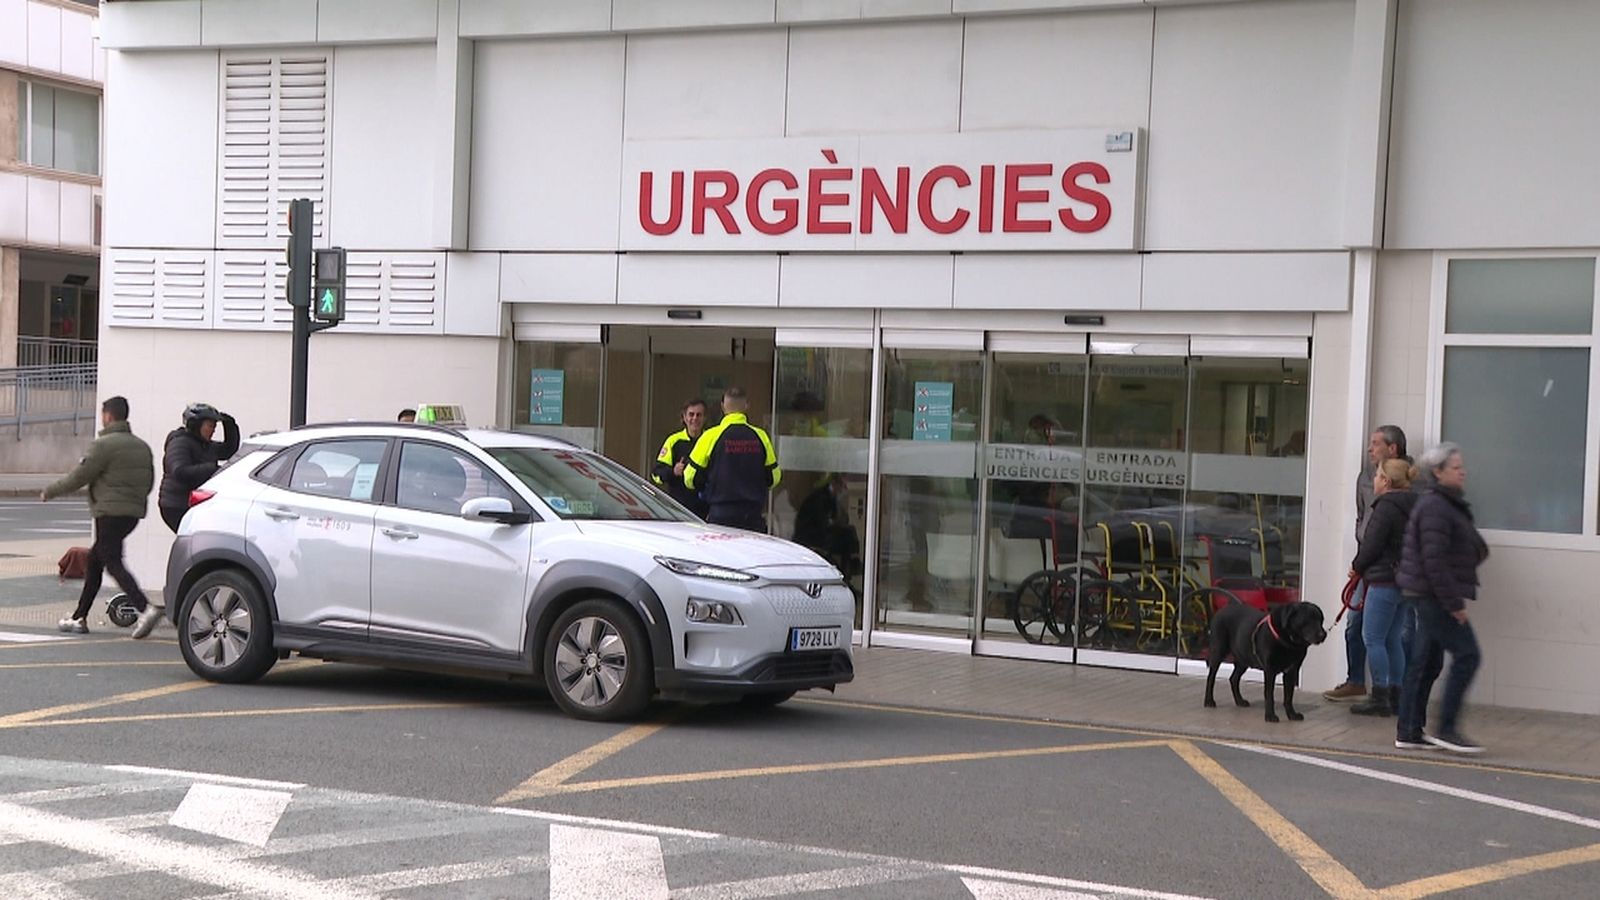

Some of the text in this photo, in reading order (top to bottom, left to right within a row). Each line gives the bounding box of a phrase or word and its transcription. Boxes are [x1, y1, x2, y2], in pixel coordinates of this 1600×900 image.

[639, 149, 1112, 235] URGÈNCIES
[994, 448, 1071, 463] ENTRADA
[1096, 453, 1176, 468] ENTRADA
[986, 463, 1080, 480] URGÈNCIES
[1086, 468, 1185, 486] URGÈNCIES
[800, 631, 839, 647] 9729 LLY
